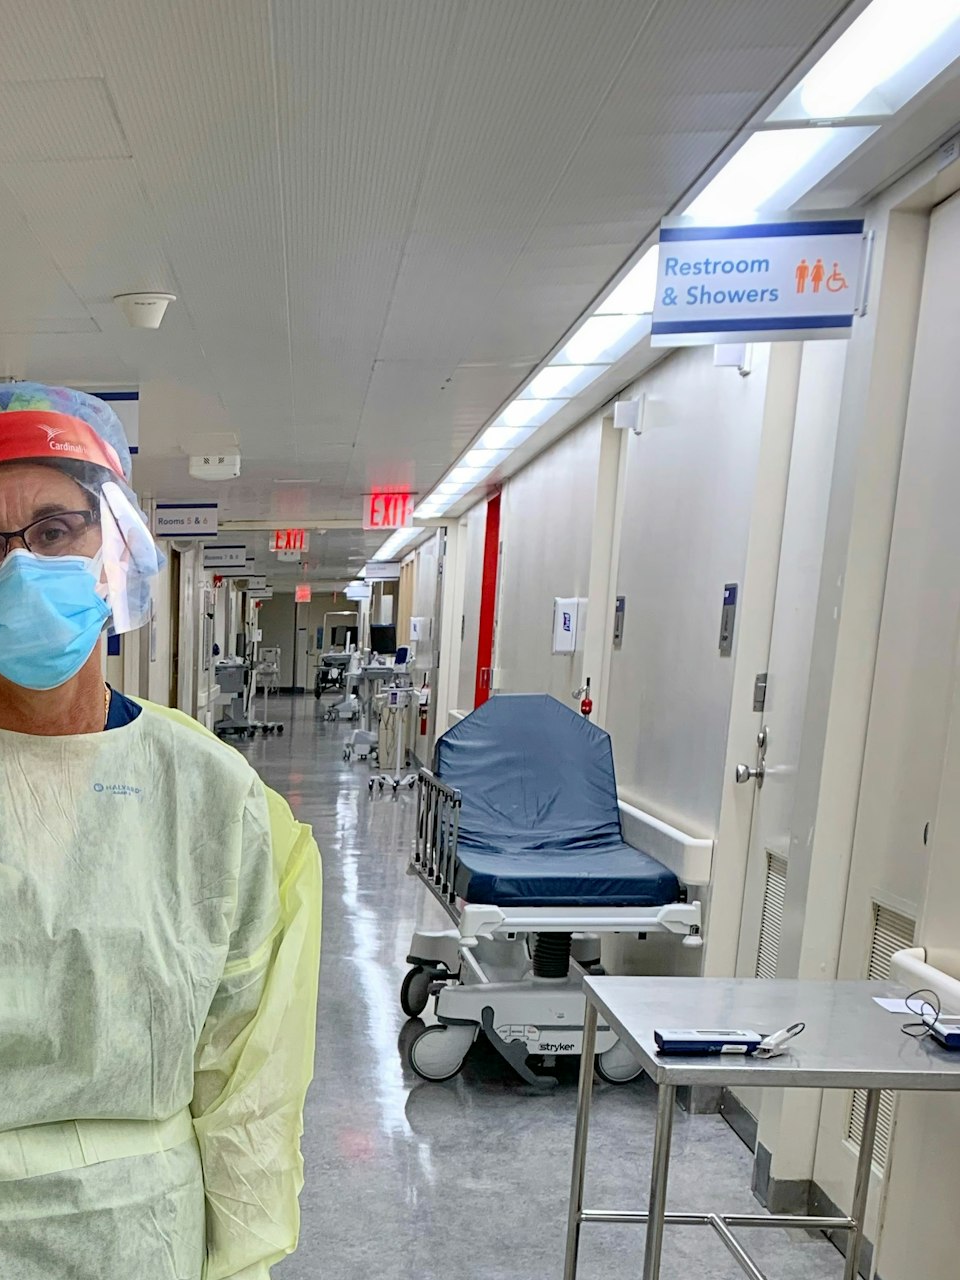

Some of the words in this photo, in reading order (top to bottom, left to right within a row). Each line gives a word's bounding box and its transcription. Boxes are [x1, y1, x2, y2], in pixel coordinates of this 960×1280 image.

[664, 257, 770, 277] Restroom
[662, 286, 678, 306] &
[685, 284, 780, 306] Showers
[369, 493, 411, 527] EXIT
[158, 517, 185, 526] Rooms
[186, 517, 192, 525] 5
[194, 517, 200, 525] &
[538, 1042, 575, 1053] stryker
